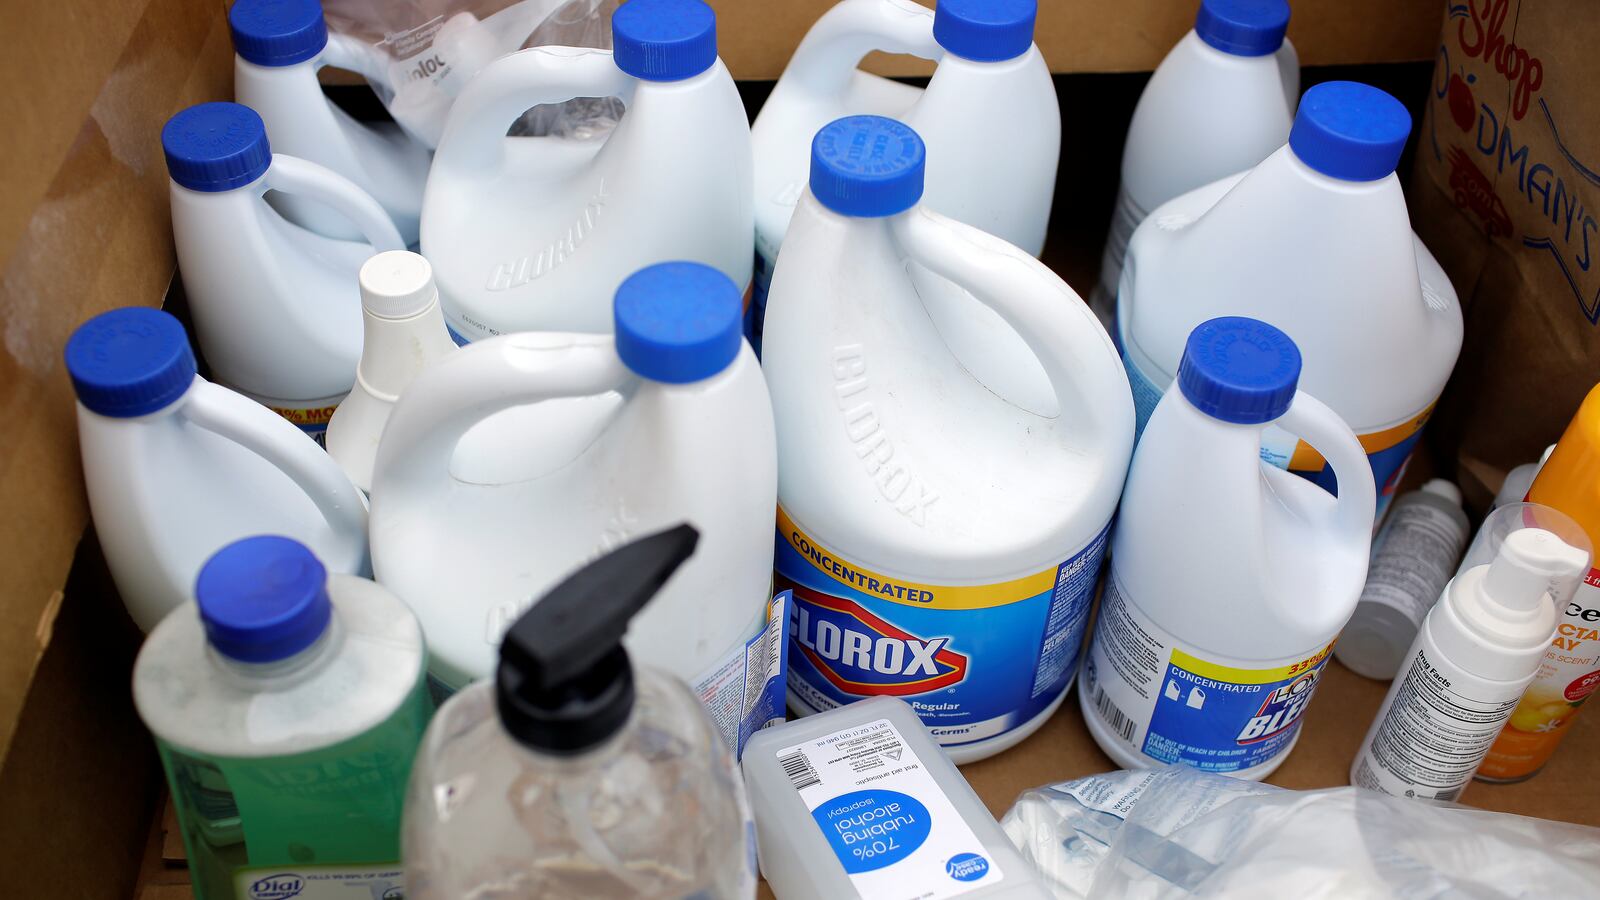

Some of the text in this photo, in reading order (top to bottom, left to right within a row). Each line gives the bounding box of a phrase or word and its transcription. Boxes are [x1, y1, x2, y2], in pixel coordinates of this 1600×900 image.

[831, 343, 940, 528] CLOROX
[792, 531, 934, 604] CONCENTRATED
[1288, 654, 1323, 675] 33%
[1419, 649, 1451, 688] Drug Facts
[1171, 666, 1261, 694] CONCENTRATED
[912, 701, 960, 711] Regular
[1148, 738, 1182, 755] DANGER:
[1165, 740, 1177, 748] OUT
[1187, 746, 1208, 755] REACH
[855, 772, 890, 785] antiseptic
[827, 798, 875, 819] isopropyl
[834, 802, 901, 833] alcohol
[842, 814, 915, 845] rubbing
[853, 837, 900, 861] 70%
[954, 864, 986, 878] ready
[254, 879, 300, 893] Dial
